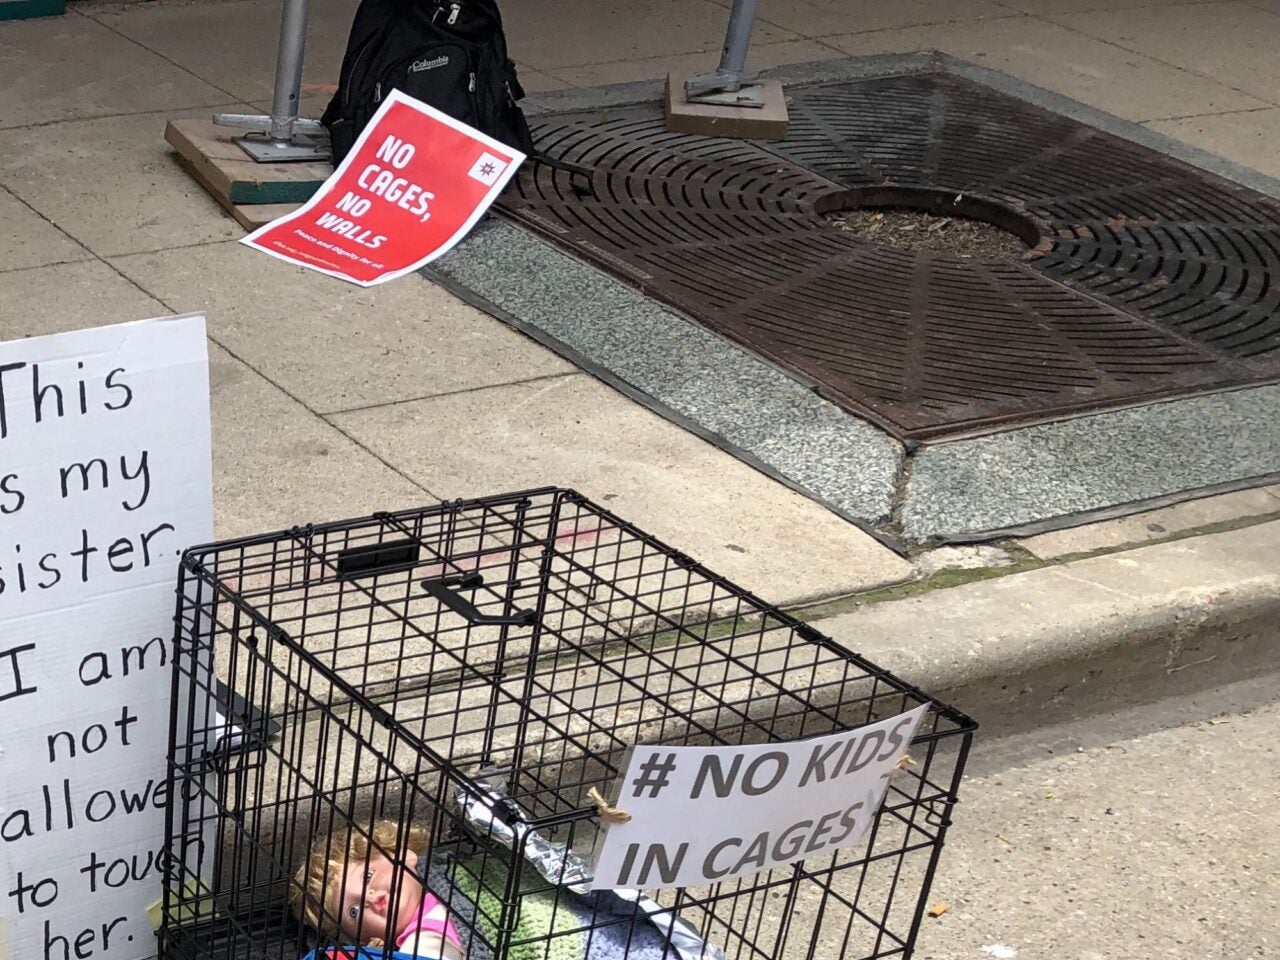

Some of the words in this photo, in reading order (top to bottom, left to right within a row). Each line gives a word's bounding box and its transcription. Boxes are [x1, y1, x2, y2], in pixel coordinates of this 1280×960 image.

[375, 134, 416, 169] NO
[335, 191, 372, 217] NO
[357, 163, 436, 223] CAGES,
[315, 211, 388, 249] WALLS
[60, 450, 150, 511] my
[79, 636, 167, 686] am
[47, 705, 138, 763] not
[631, 752, 677, 799] #
[689, 750, 790, 800] NO
[798, 716, 913, 788] KIDS
[616, 842, 690, 886] IN
[701, 801, 865, 880] CAGES
[8, 872, 58, 913] to
